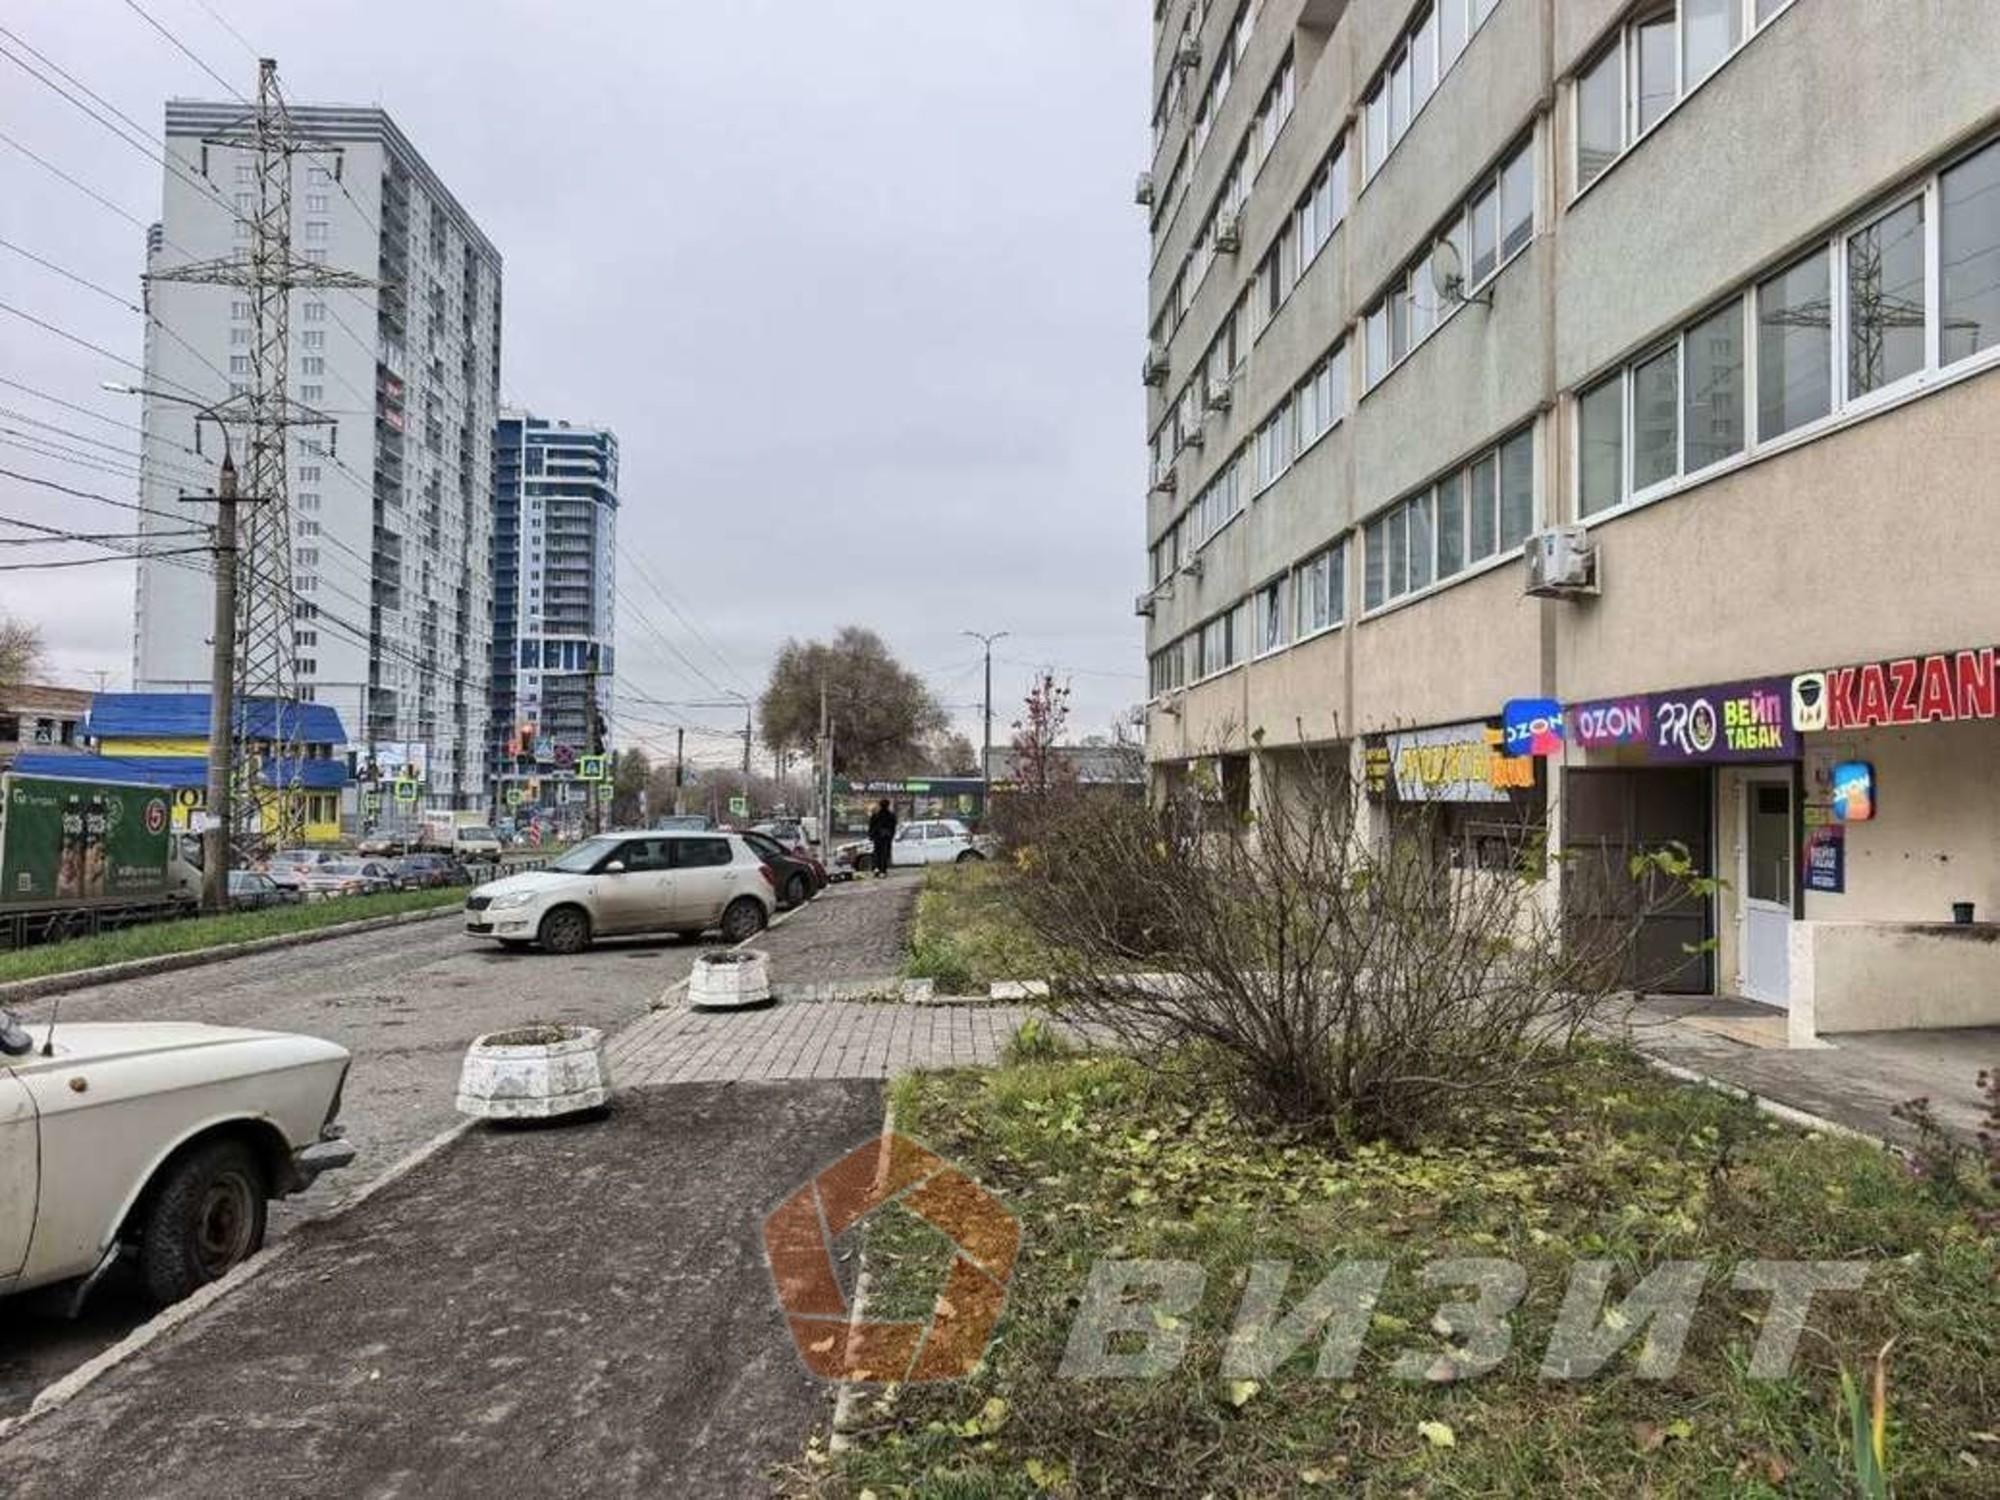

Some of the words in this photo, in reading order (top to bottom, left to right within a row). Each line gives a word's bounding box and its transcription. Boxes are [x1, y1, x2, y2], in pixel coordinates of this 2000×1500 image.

[1826, 648, 1996, 730] KAZAN
[1579, 706, 1643, 739] OZON
[1723, 691, 1782, 726] ВЕЙП
[1656, 699, 1717, 754] PRO
[1725, 725, 1784, 750] ТАБАК
